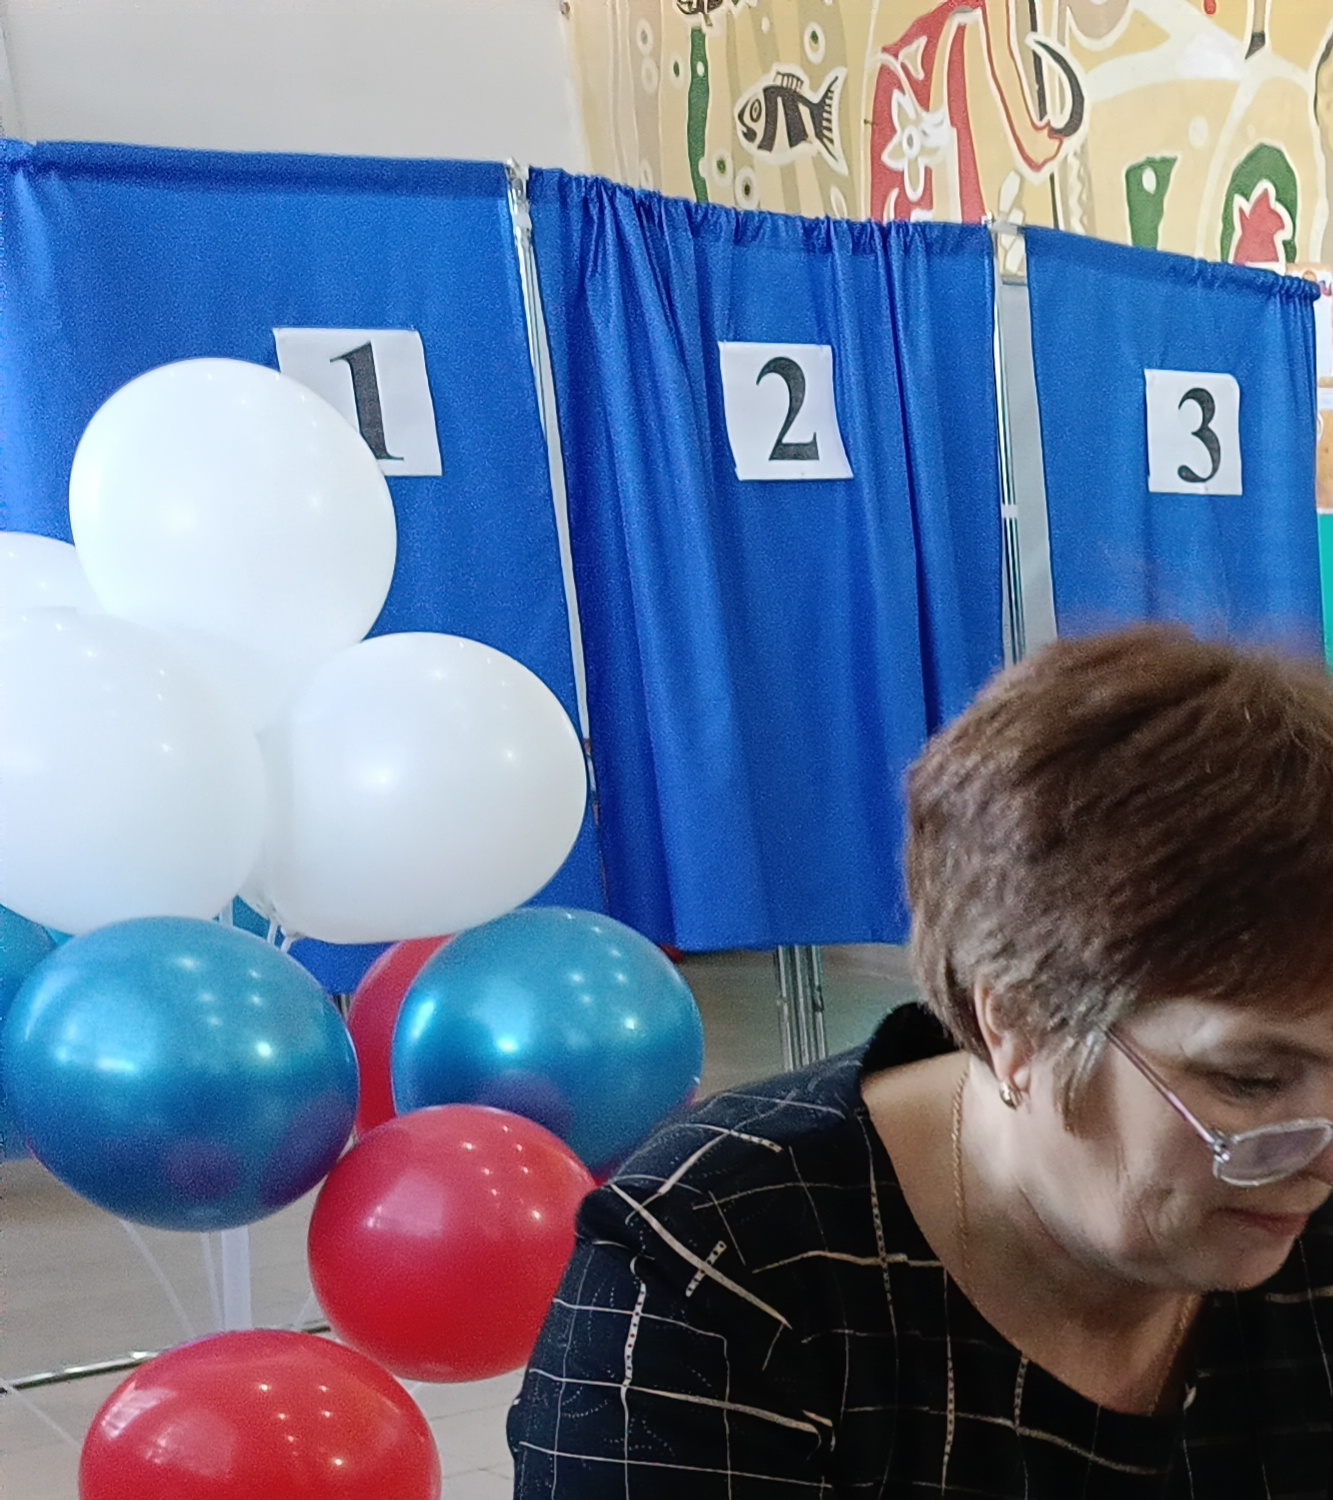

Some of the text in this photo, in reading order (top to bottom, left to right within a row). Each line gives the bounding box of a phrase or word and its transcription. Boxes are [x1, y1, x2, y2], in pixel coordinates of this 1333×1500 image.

[330, 341, 404, 462] 1
[756, 356, 819, 461] 2
[1177, 387, 1221, 483] 3
